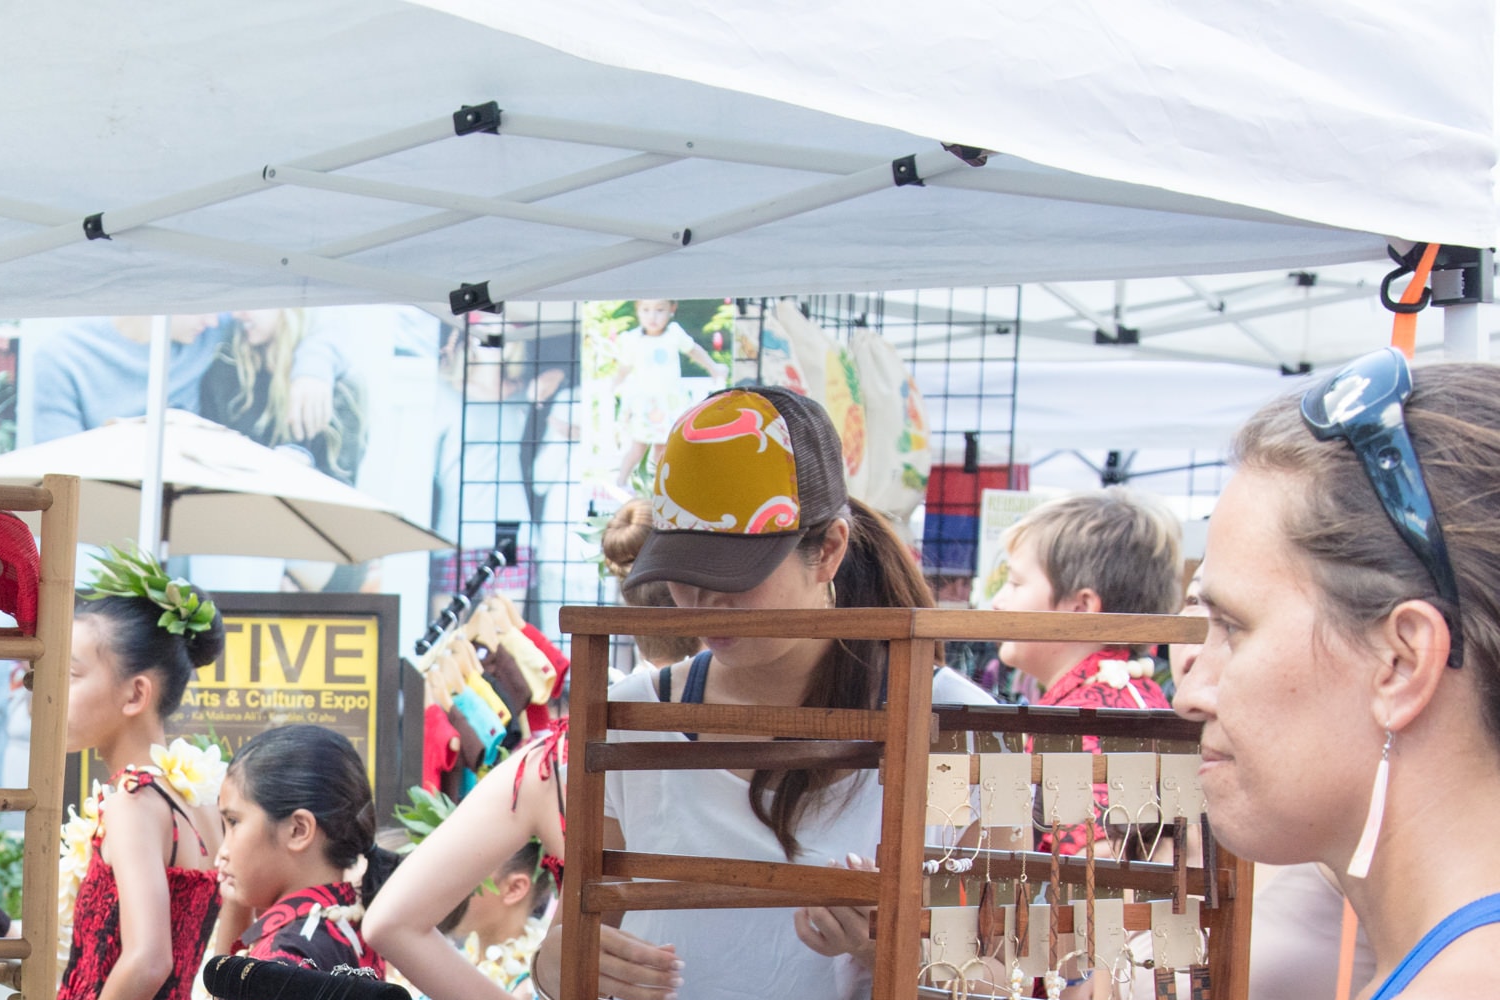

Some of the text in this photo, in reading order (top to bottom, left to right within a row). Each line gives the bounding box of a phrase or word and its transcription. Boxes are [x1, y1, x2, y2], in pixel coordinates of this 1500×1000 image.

[192, 624, 367, 684] TIVE
[180, 690, 369, 713] Arts & Culture Expo
